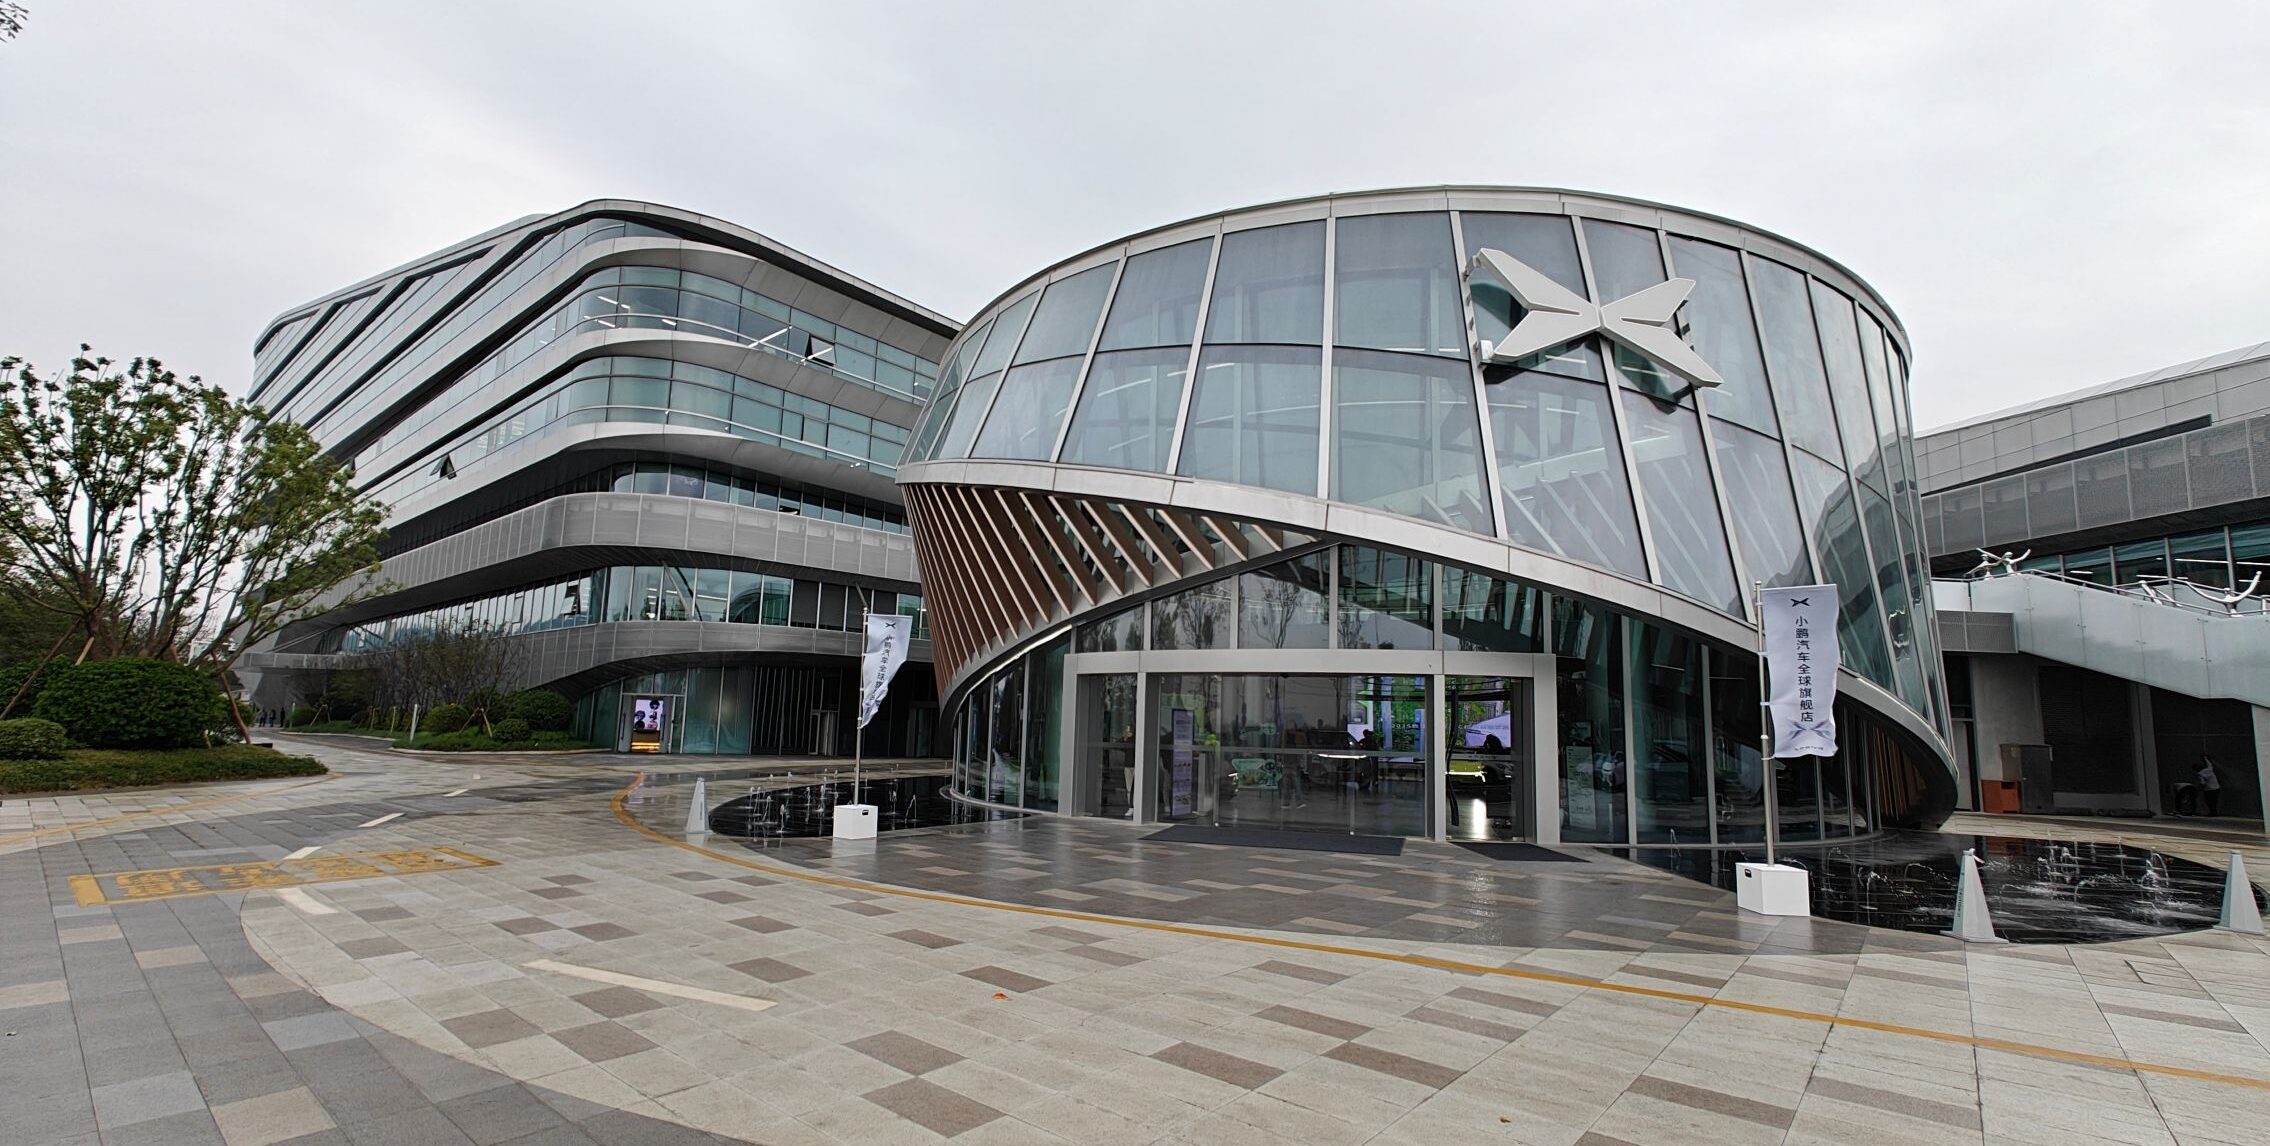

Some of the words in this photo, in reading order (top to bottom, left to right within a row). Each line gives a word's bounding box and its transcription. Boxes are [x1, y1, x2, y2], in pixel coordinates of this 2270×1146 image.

[1795, 615, 1814, 723] 小鹏汽车全球旗舰店
